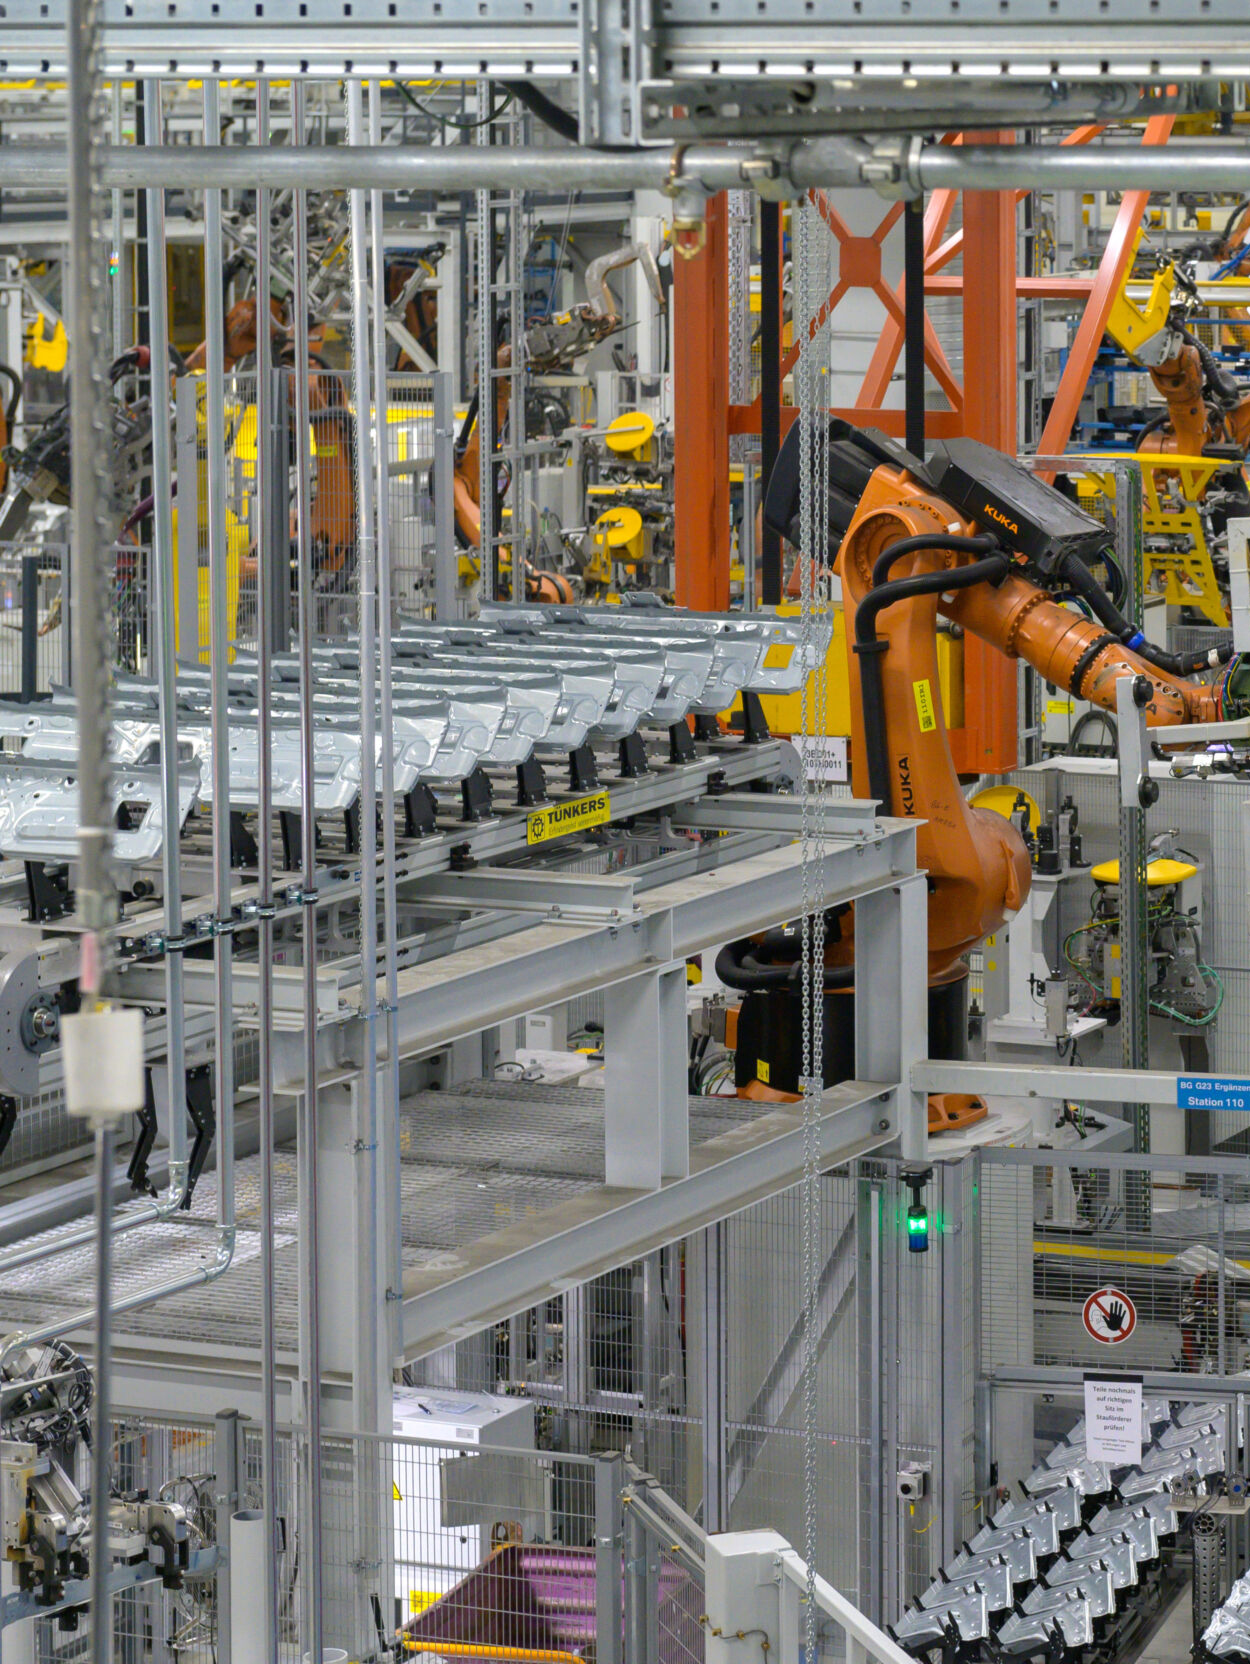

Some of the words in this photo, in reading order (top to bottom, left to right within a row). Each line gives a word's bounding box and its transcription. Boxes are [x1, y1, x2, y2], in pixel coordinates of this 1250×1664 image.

[984, 504, 1018, 535] KUKA
[898, 756, 915, 816] KUKA
[548, 798, 606, 824] TÜNKERS
[1180, 1081, 1193, 1089] BG
[1195, 1082, 1212, 1090] G23
[1188, 1096, 1224, 1107] Station
[1226, 1098, 1245, 1108] 110
